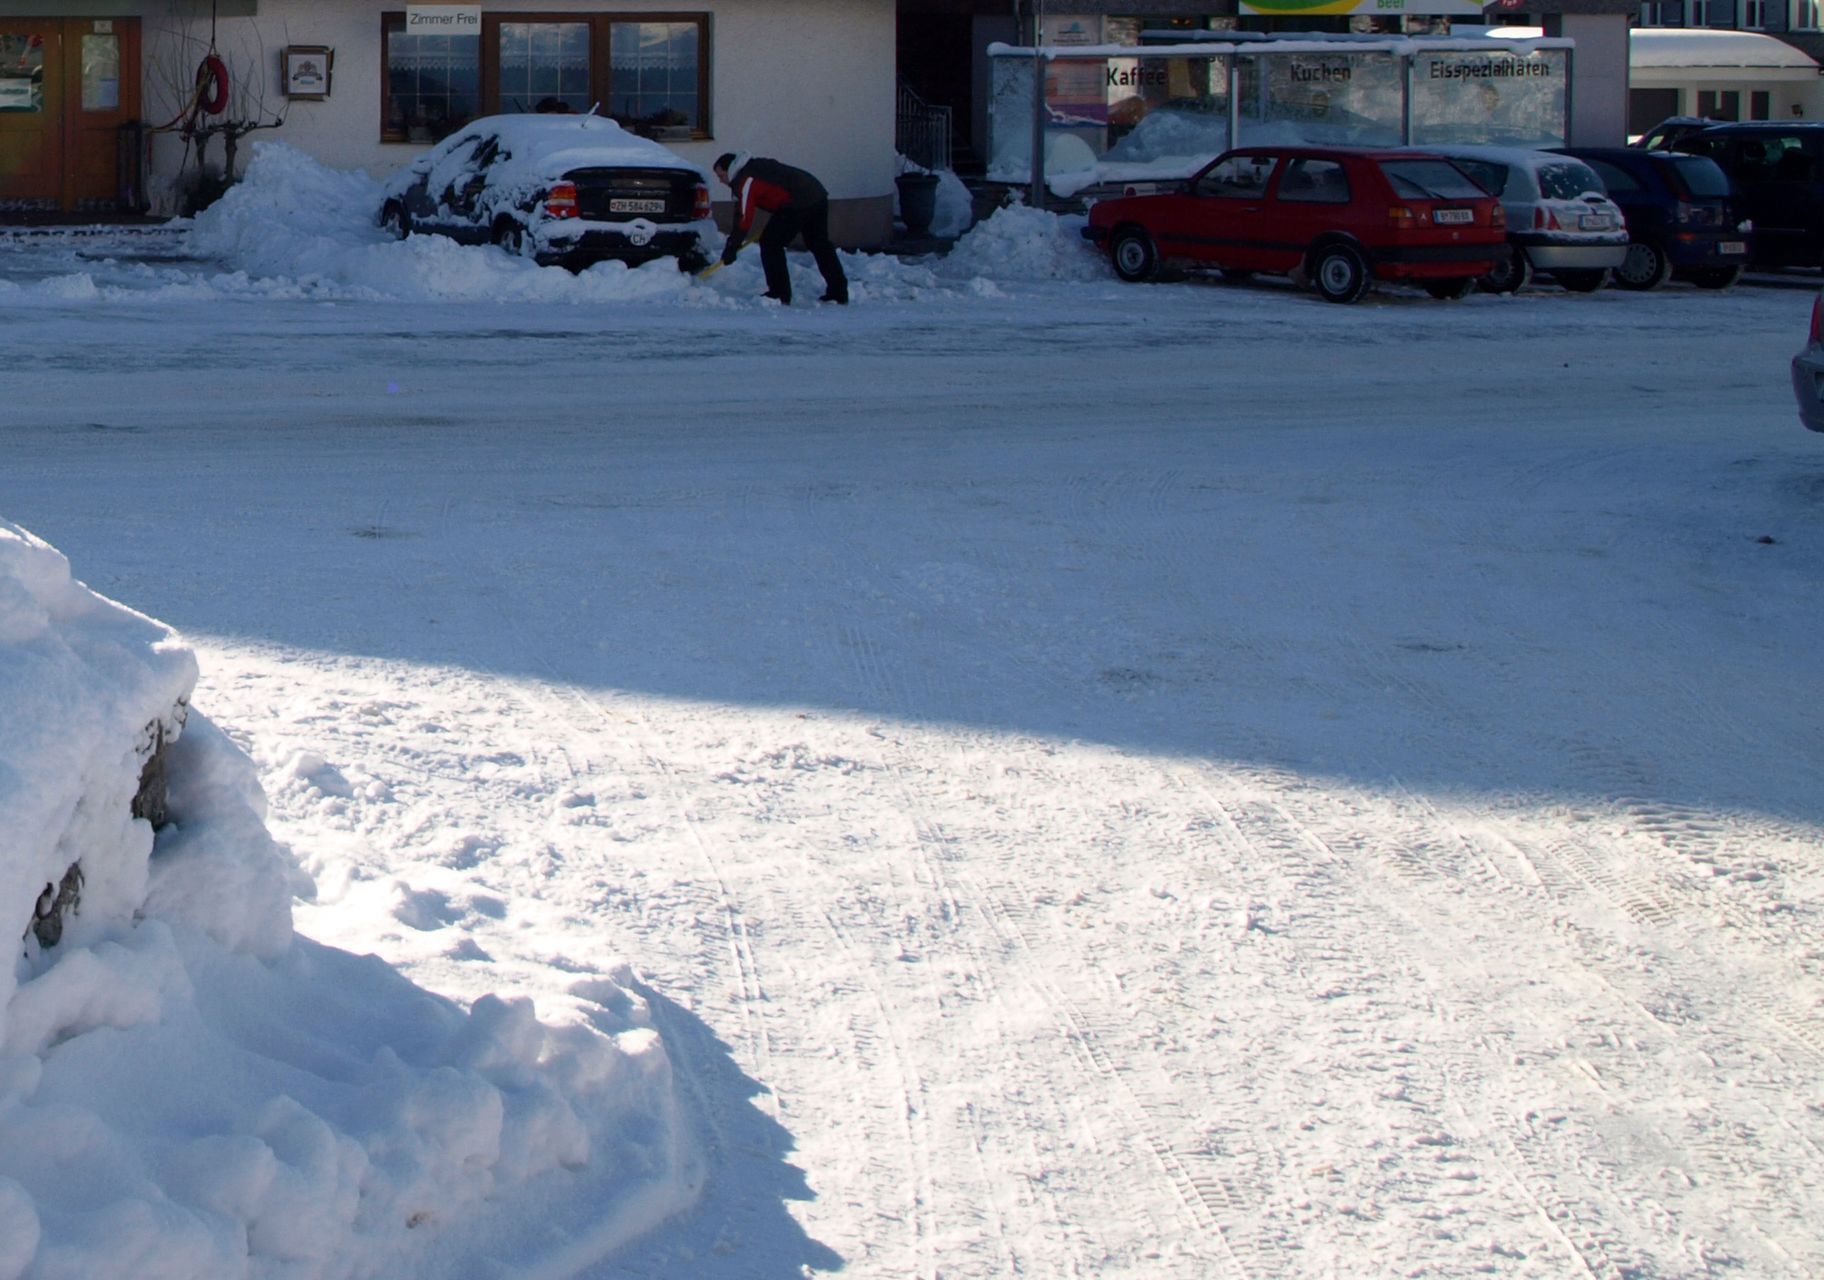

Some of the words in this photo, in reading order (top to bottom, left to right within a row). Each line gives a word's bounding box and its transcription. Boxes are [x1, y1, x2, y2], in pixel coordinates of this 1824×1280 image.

[410, 12, 454, 25] Zimmer
[456, 12, 479, 25] Frei
[1107, 67, 1167, 86] Kaffee
[1290, 62, 1352, 83] Kuchen
